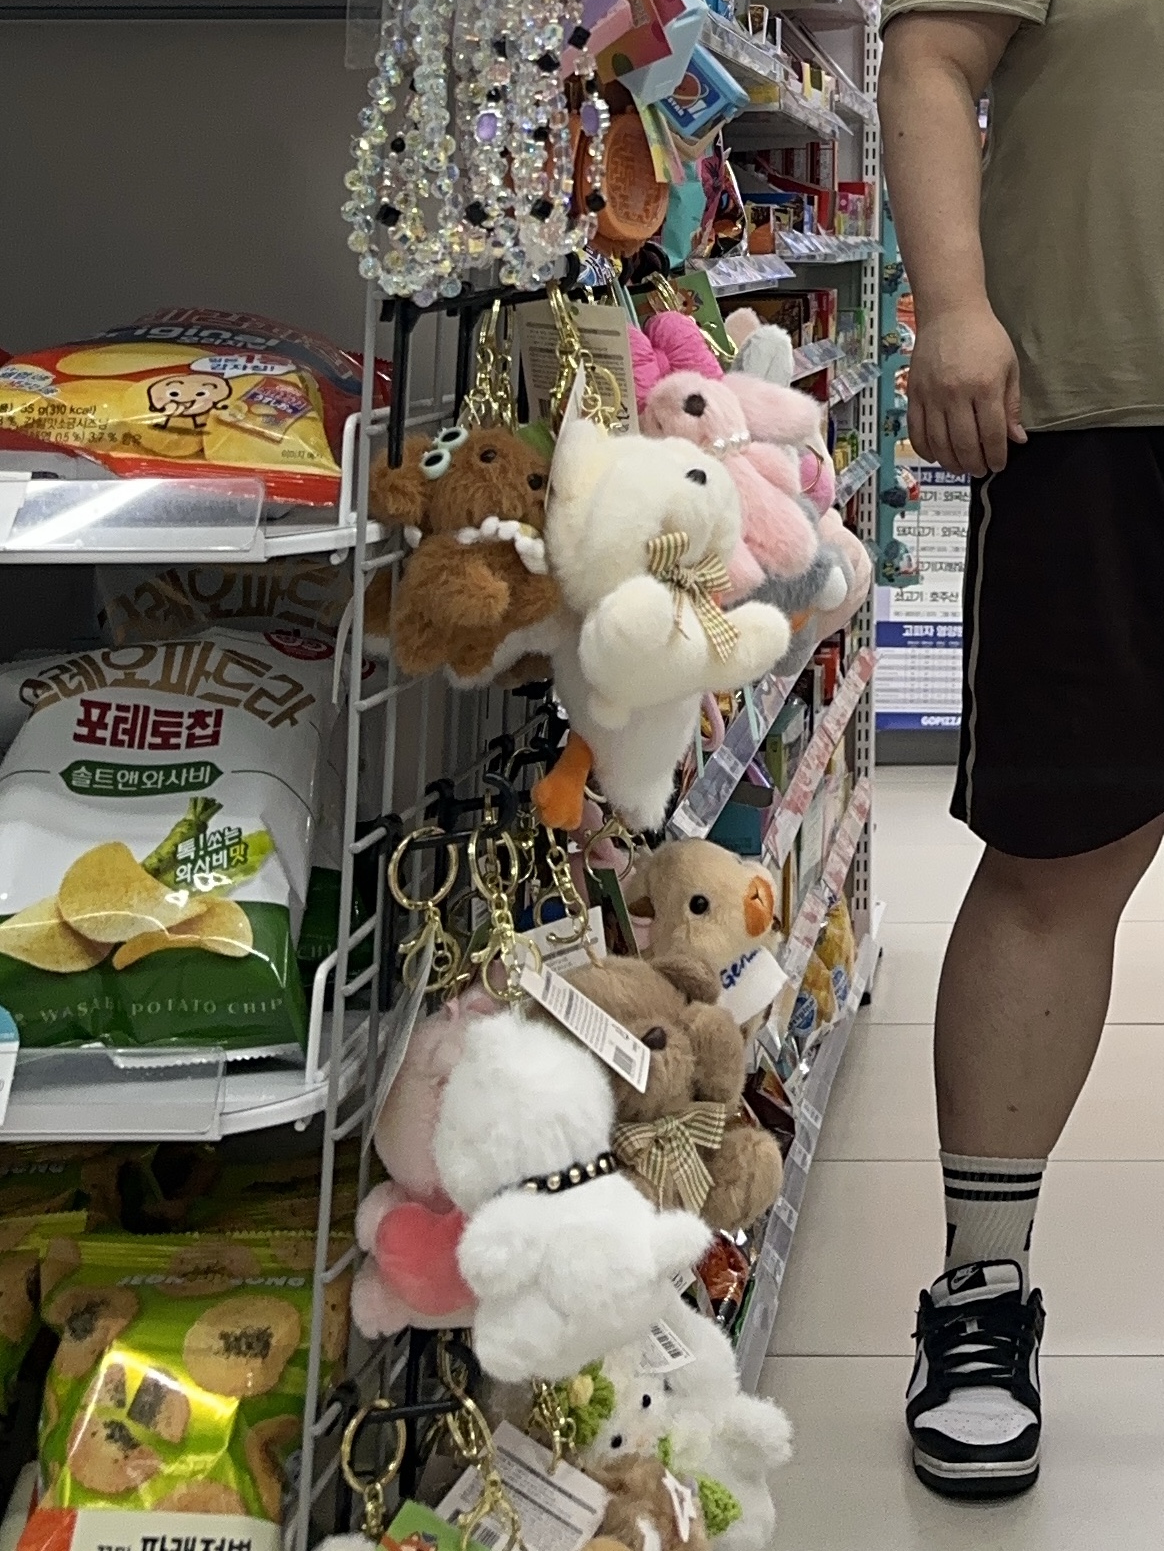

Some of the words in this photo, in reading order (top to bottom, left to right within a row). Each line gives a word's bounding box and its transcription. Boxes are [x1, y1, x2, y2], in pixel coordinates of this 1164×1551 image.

[98, 325, 280, 348] riginal
[920, 491, 938, 502] 고기
[896, 525, 935, 537] 돼지고기
[930, 591, 959, 603] 호주산
[72, 698, 224, 751] 포테토칩
[71, 765, 211, 791] 솔트앤와사비
[175, 842, 248, 883] 와사비맛
[131, 998, 218, 1017] POTATO
[227, 998, 283, 1015] CHIP
